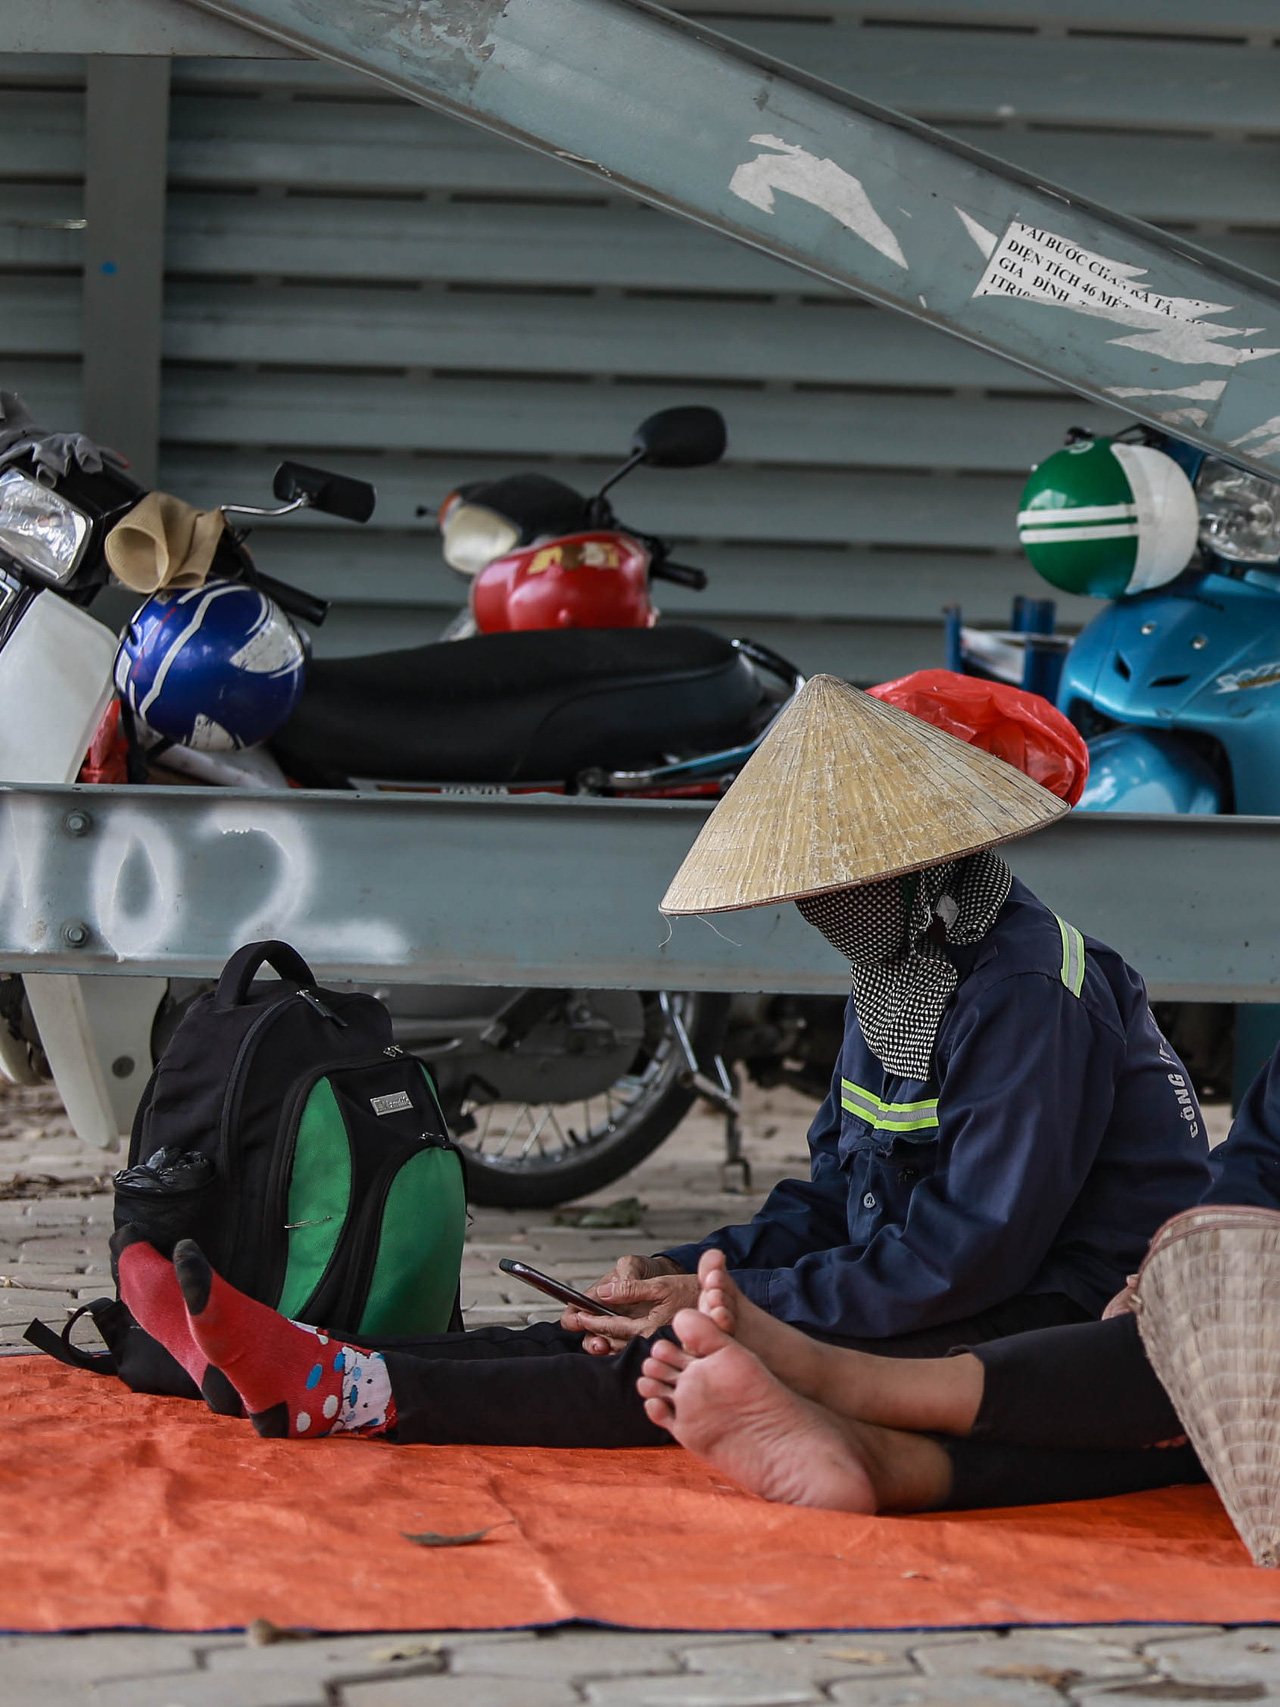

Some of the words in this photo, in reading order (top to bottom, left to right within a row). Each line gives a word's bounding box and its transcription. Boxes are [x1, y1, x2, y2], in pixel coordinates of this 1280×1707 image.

[998, 256, 1024, 279] GIA
[1044, 259, 1082, 288] TÍCH
[1081, 282, 1099, 297] 46
